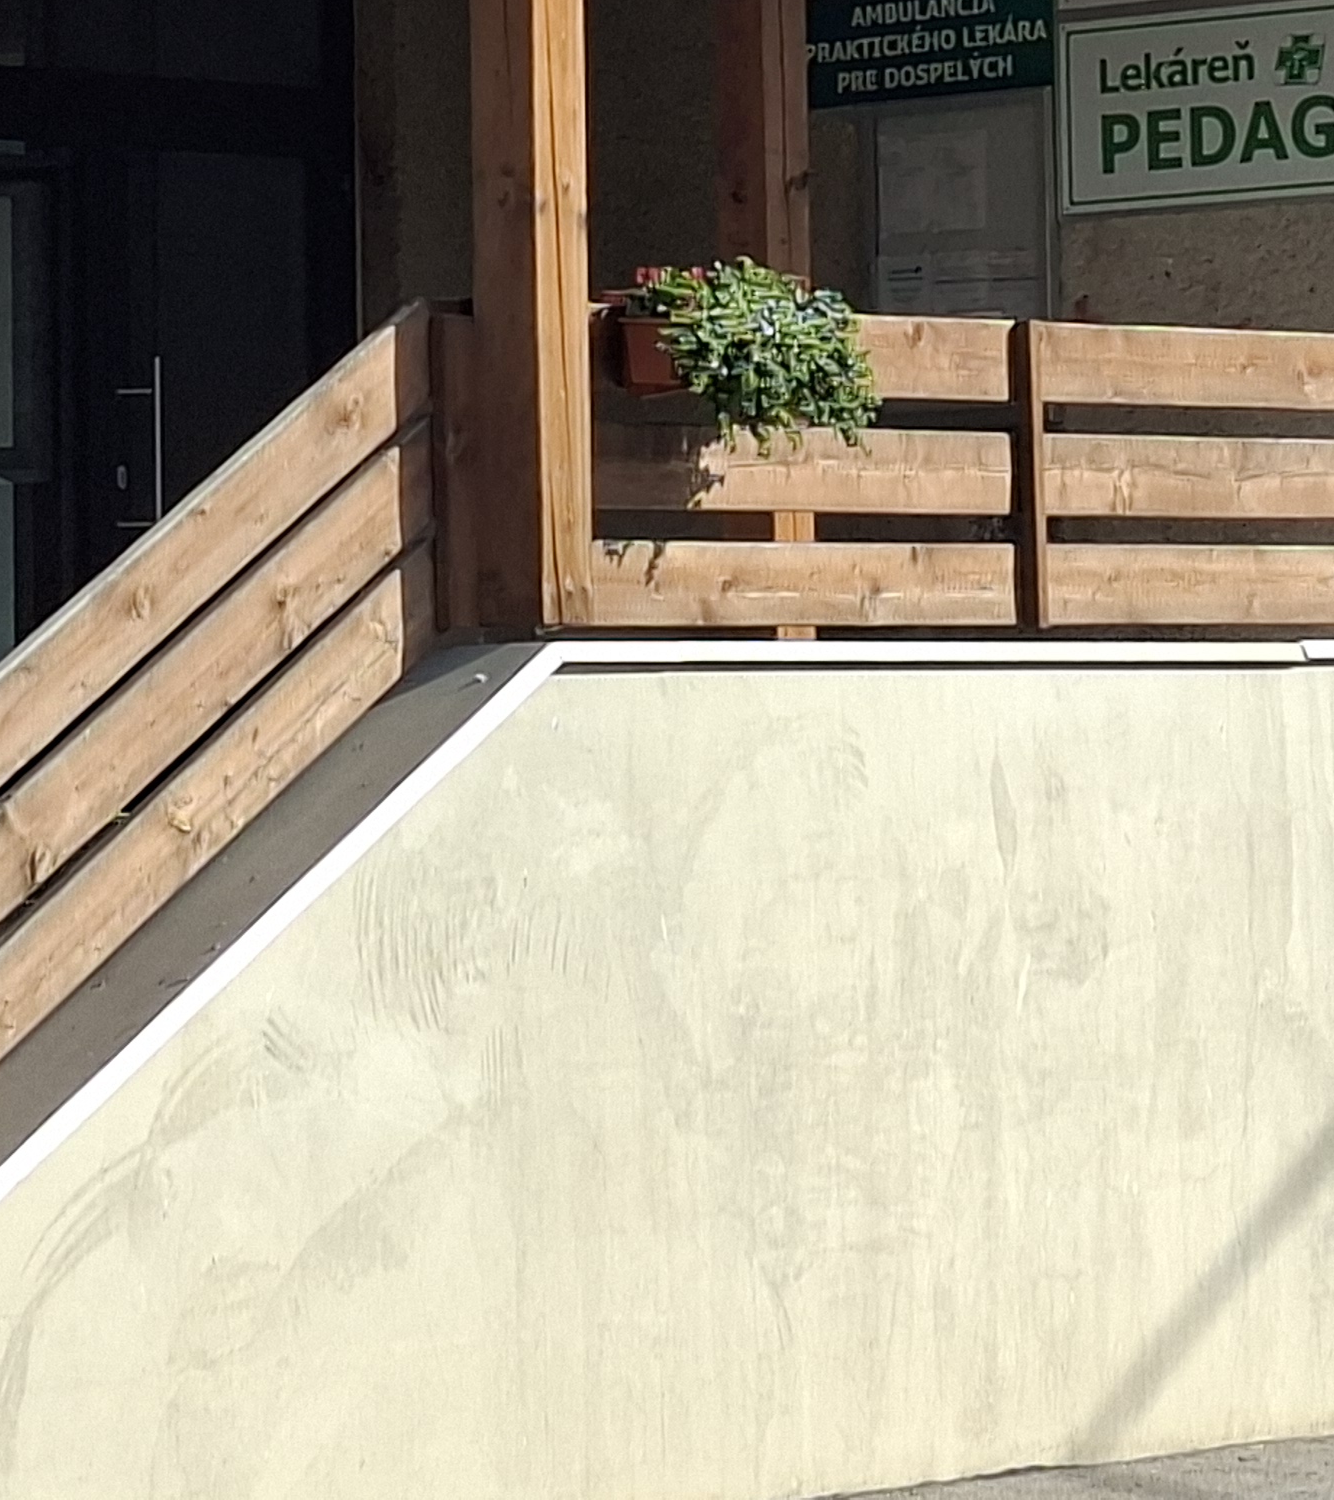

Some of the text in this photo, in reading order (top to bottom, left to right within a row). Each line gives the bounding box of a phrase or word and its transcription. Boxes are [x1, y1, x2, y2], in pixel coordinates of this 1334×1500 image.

[962, 13, 1047, 48] LEKÁRA
[837, 51, 1013, 94] PRE DOSPELÝCH
[1099, 39, 1255, 94] Lekáreň
